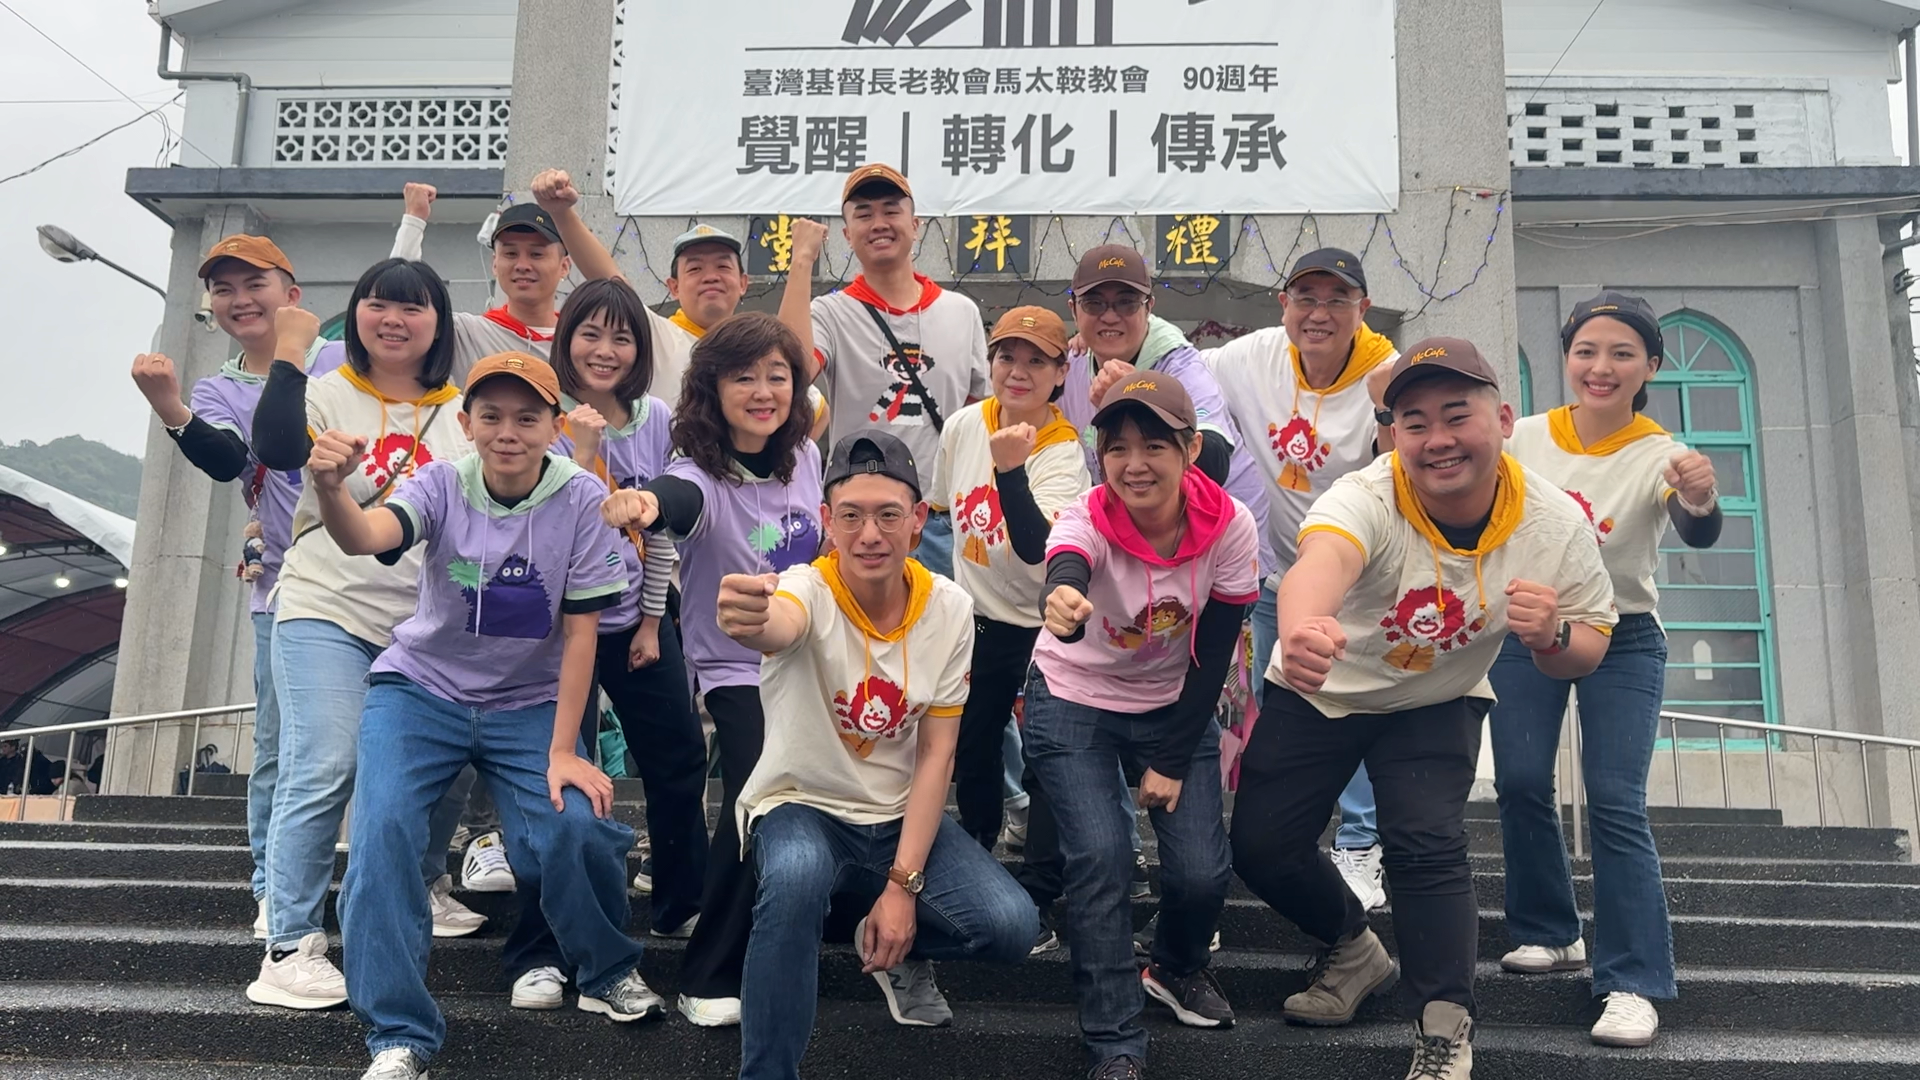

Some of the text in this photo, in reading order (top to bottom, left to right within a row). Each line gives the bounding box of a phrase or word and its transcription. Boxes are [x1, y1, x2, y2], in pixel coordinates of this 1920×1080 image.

[743, 65, 1278, 96] 臺灣基督長老教會馬太鞍教會 90週年
[738, 112, 1287, 176] 覺醒 轉化 傳承
[964, 215, 1022, 272] 拜
[1165, 214, 1220, 265] 禮
